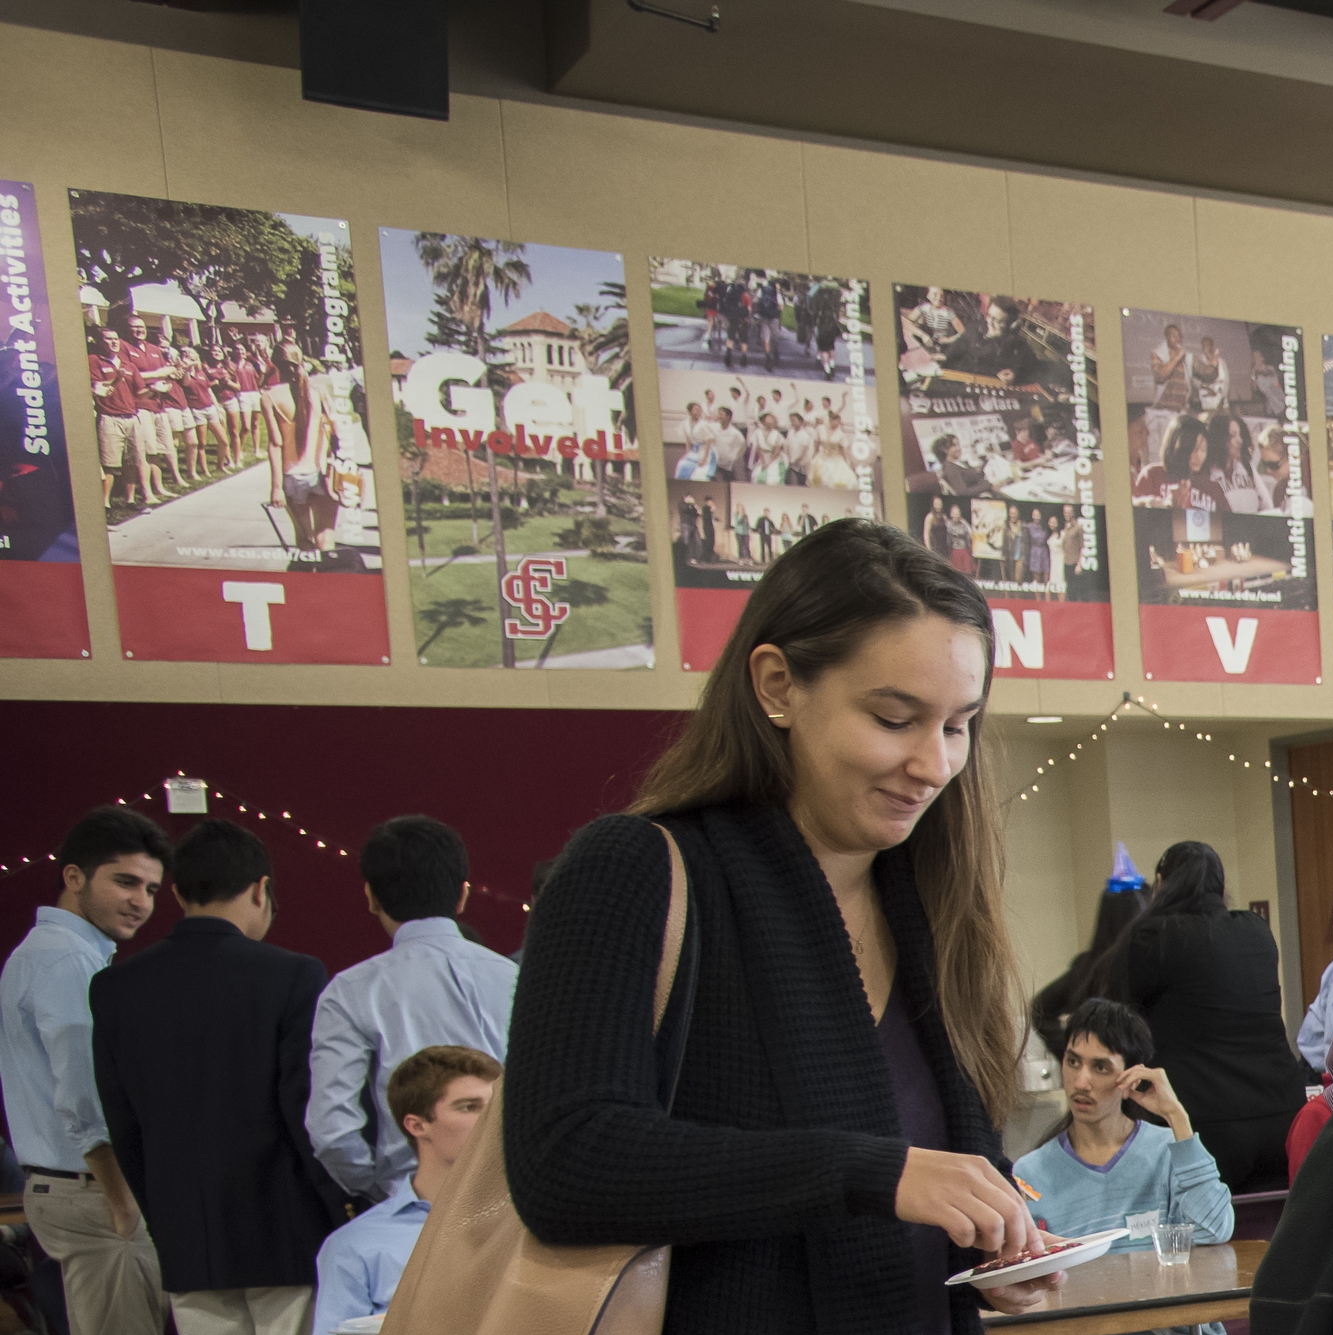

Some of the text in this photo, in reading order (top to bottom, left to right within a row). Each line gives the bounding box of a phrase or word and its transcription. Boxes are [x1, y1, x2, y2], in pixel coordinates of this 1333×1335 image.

[0, 194, 50, 456] Student Activities
[317, 231, 350, 363] Programs
[326, 368, 359, 475] Student
[405, 353, 625, 446] Get
[413, 418, 624, 461] Involved!
[843, 289, 875, 519] dent Organizations
[1067, 313, 1099, 571] Student Organizations
[1279, 335, 1307, 578] Multicultural Learning
[176, 546, 322, 562] www.scu.edu/csl
[221, 580, 286, 651] T
[991, 607, 1044, 670] N
[1205, 616, 1259, 675] V
